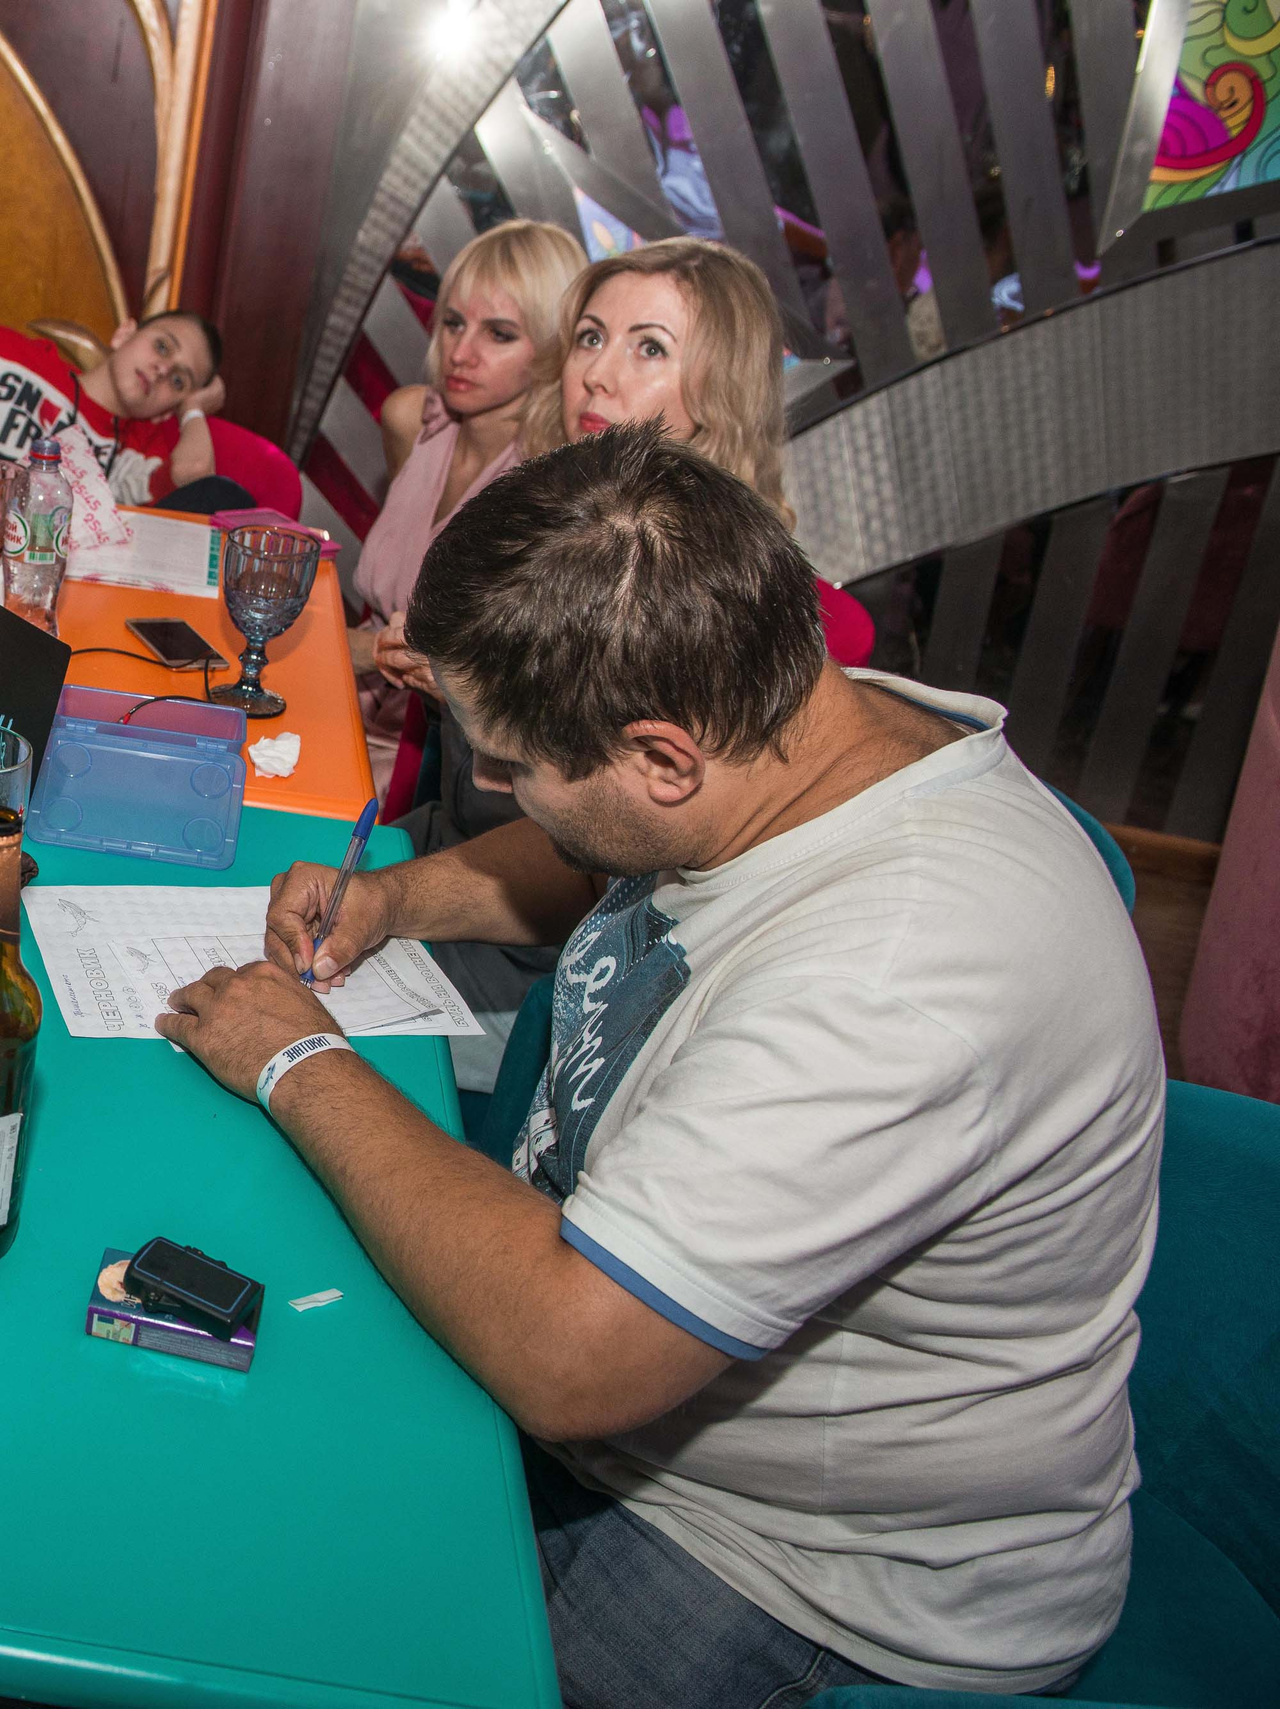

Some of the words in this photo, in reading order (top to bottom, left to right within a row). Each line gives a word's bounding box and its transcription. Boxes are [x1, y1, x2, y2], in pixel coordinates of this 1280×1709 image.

[405, 951, 440, 983] ВОЛНЕ
[76, 948, 125, 1032] ЧЕРНОВИК
[431, 983, 451, 999] НА
[442, 998, 470, 1028] БУДЬ
